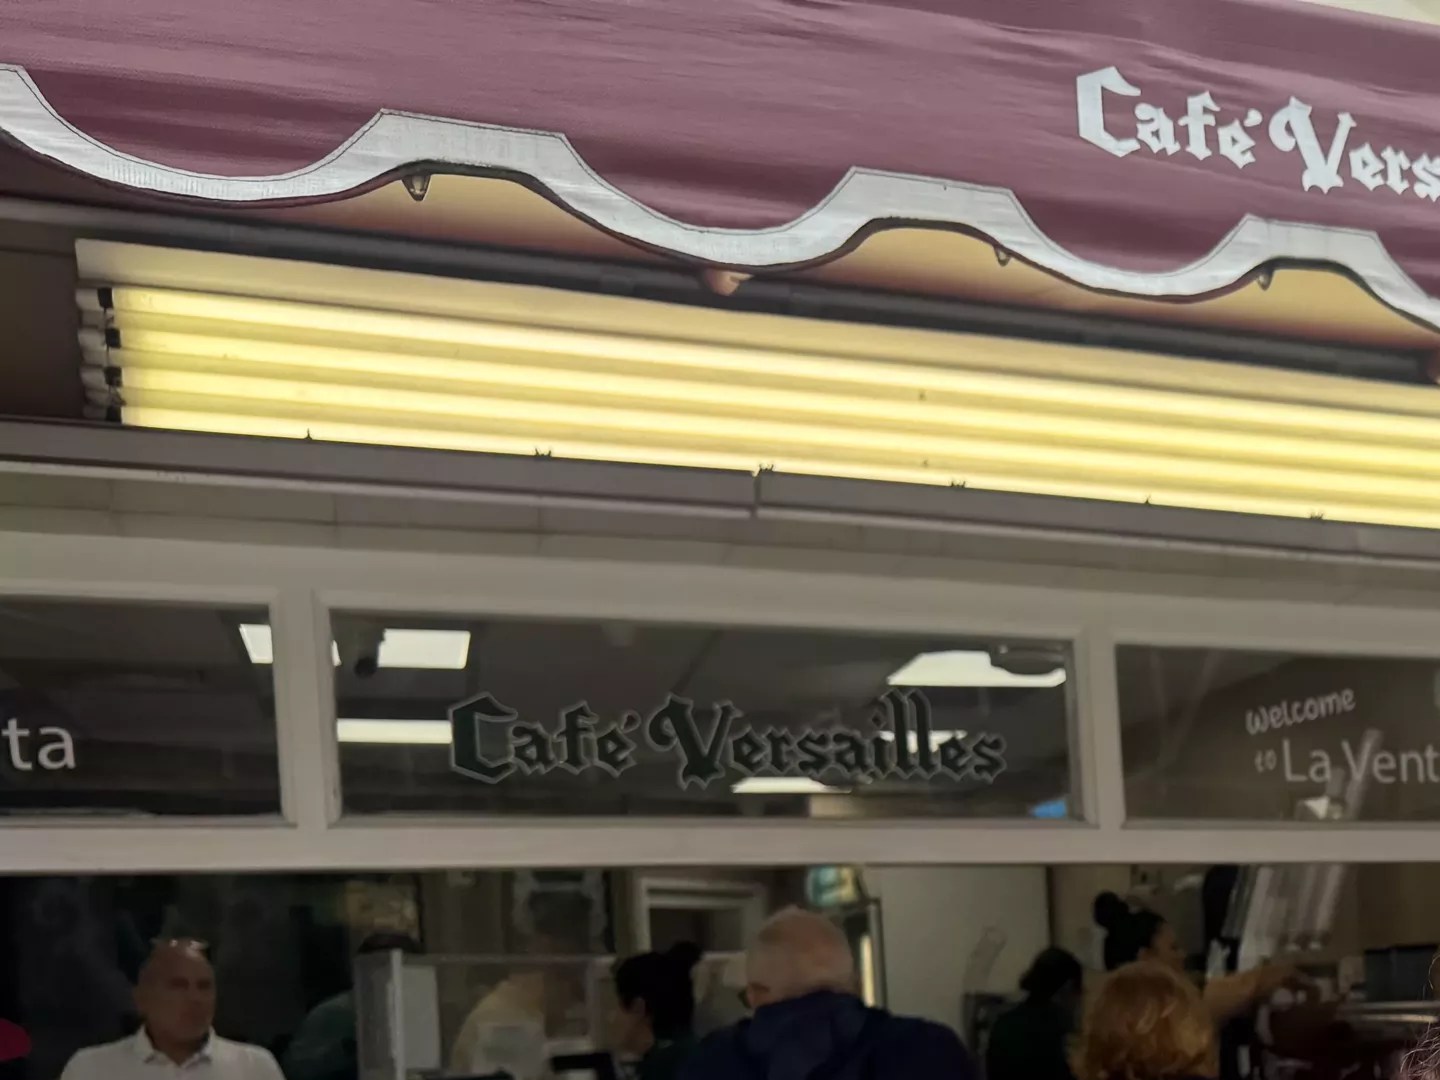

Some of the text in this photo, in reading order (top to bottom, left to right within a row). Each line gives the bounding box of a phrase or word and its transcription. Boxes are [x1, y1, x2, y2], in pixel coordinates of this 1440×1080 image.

[645, 687, 1008, 791] Versailles
[1254, 748, 1277, 773] to
[1282, 737, 1332, 783] La
